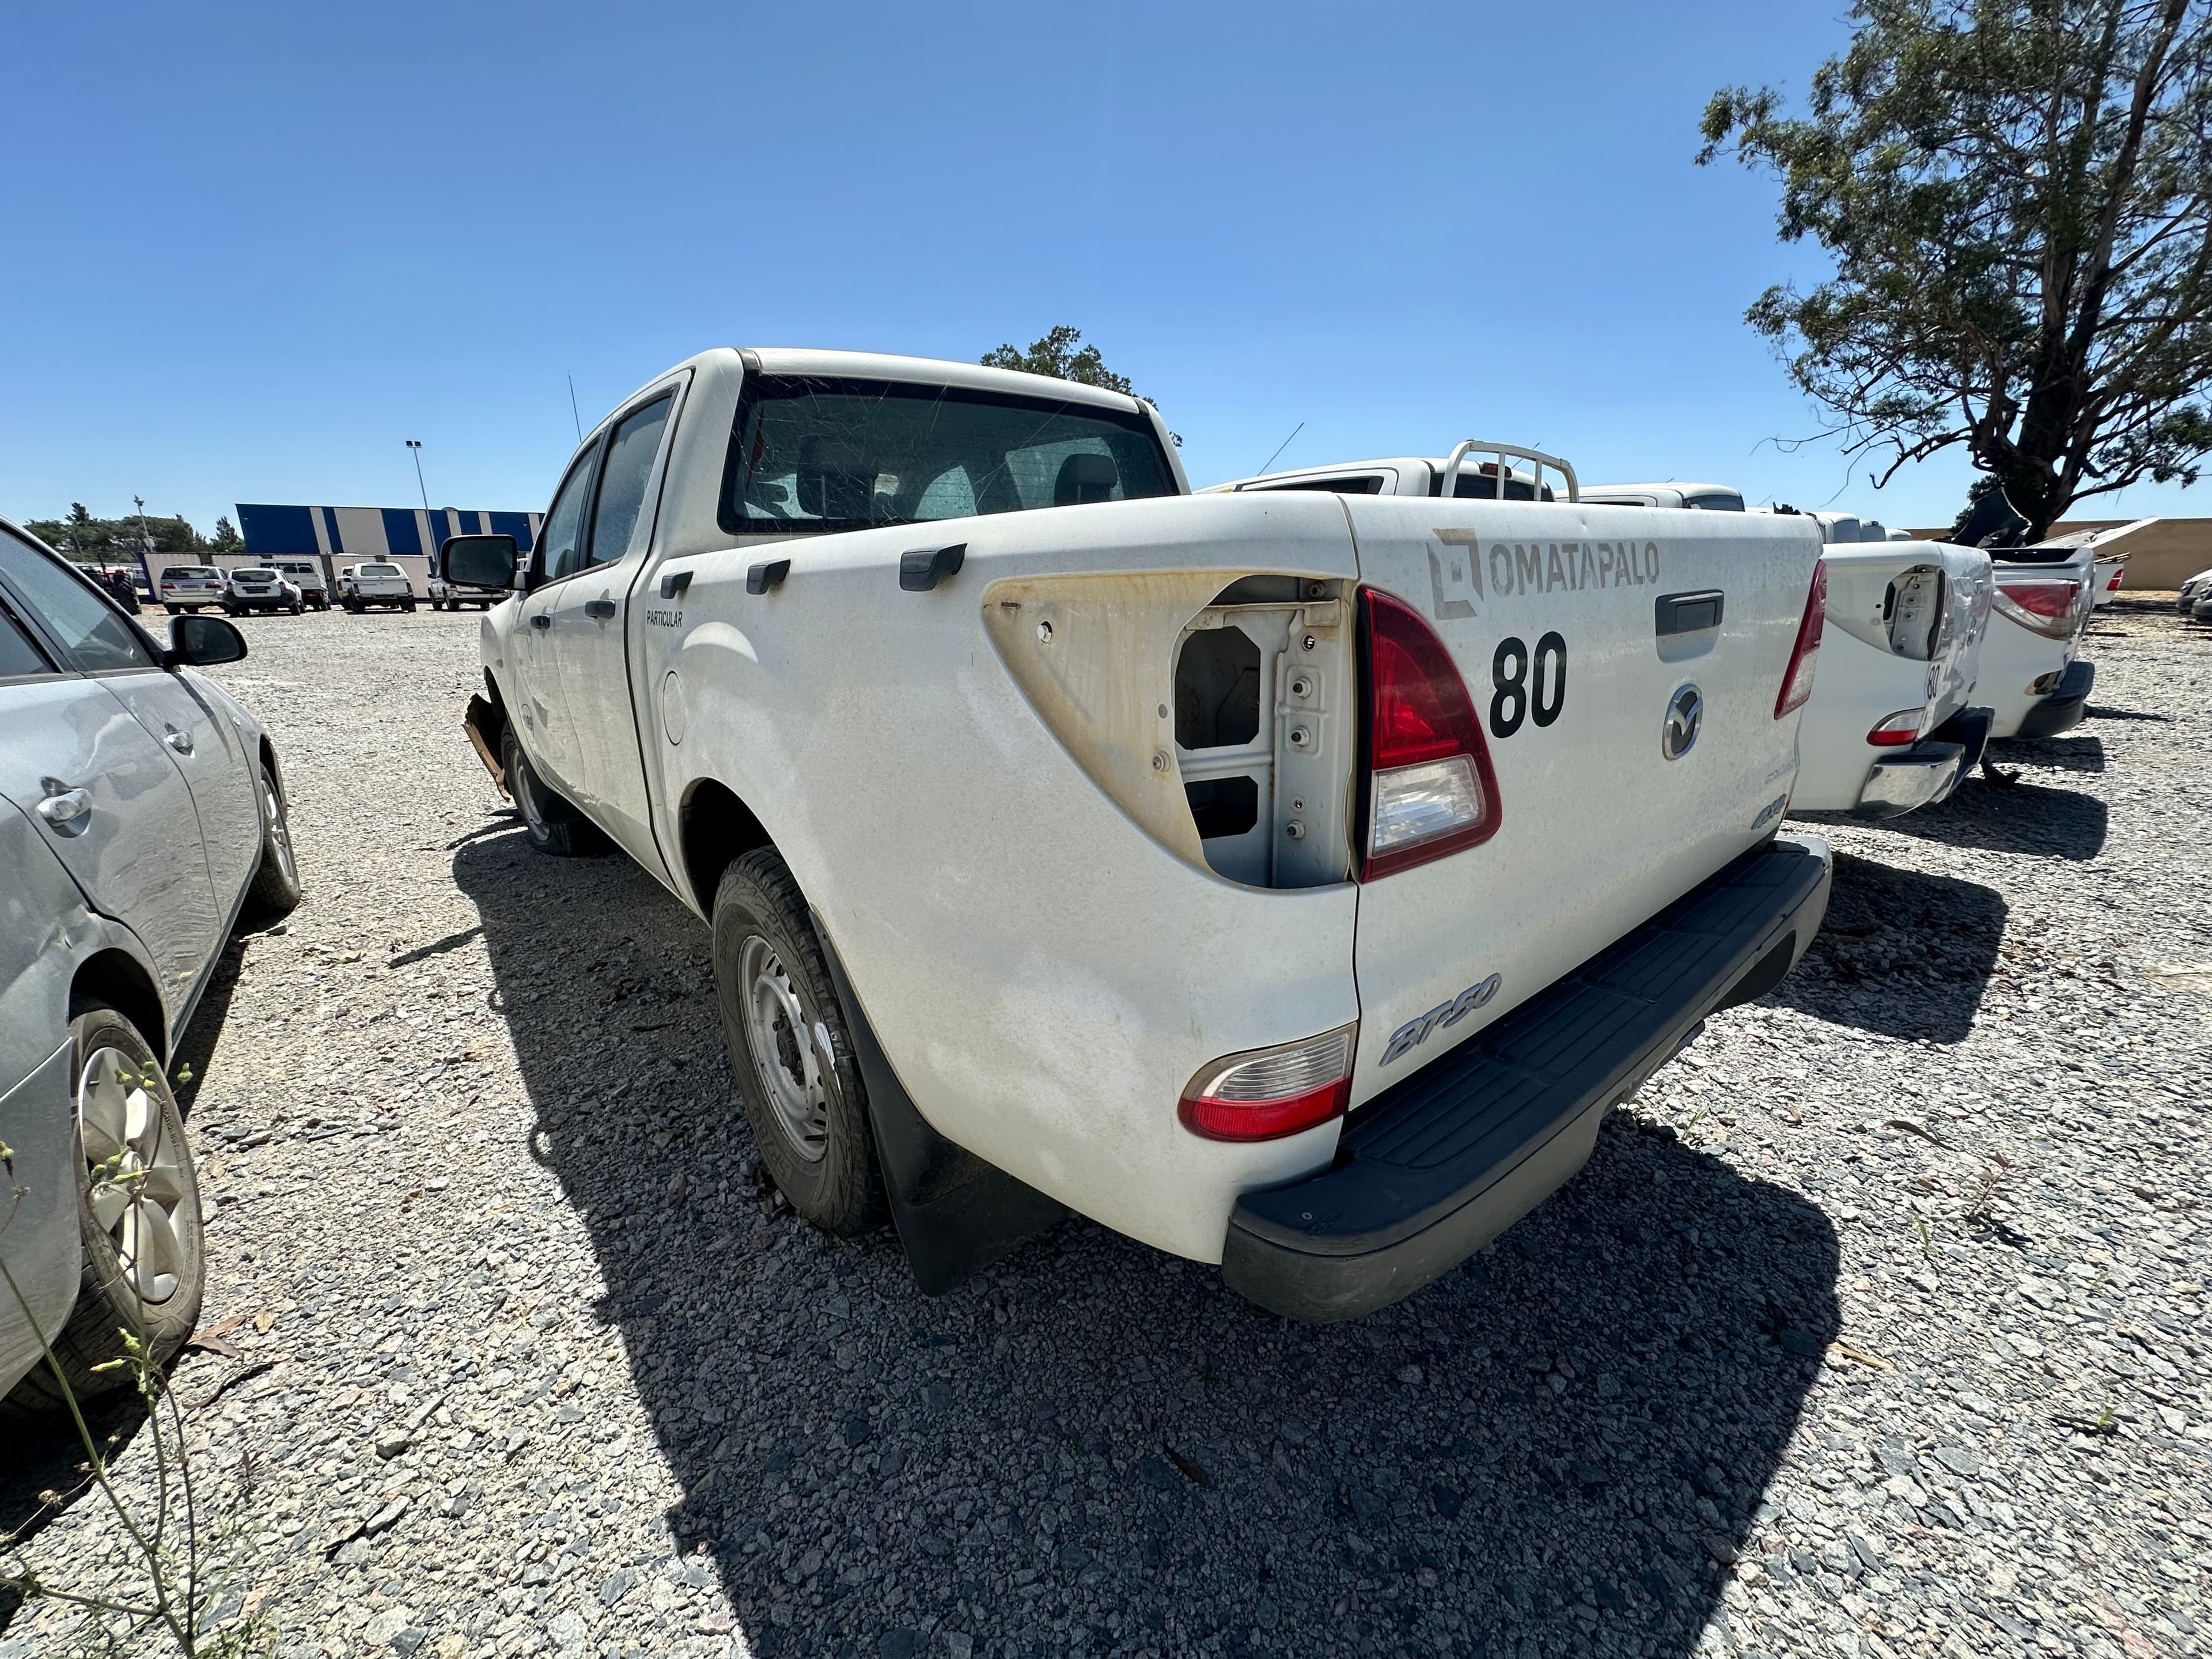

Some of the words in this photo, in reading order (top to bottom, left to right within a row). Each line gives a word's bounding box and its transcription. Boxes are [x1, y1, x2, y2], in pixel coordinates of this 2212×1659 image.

[1489, 541, 1659, 597] OMATAPALO
[647, 610, 683, 627] PARTICULAR
[1490, 631, 1567, 738] 80
[1927, 665, 1940, 700] 80
[1379, 973, 1502, 1067] BT-50
